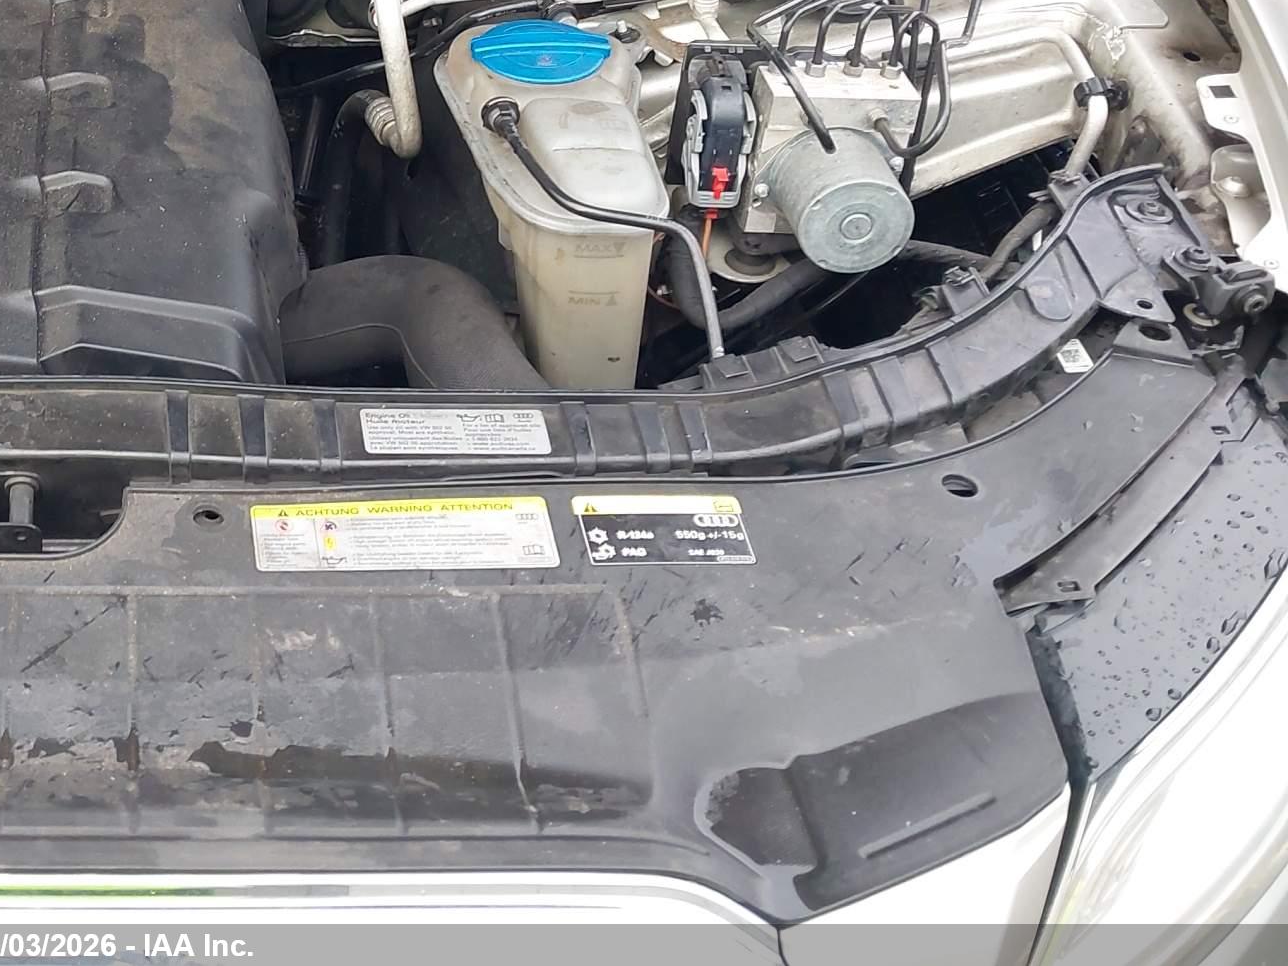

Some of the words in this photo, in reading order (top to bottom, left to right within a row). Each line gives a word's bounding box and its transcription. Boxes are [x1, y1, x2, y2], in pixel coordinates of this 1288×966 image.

[575, 242, 612, 253] MAX
[567, 296, 601, 306] MIN
[365, 412, 396, 420] Engine
[295, 507, 360, 517] ACHTUNG
[367, 504, 433, 514] WARNING
[440, 502, 514, 512] ATTENTION
[621, 547, 648, 557] PAG
